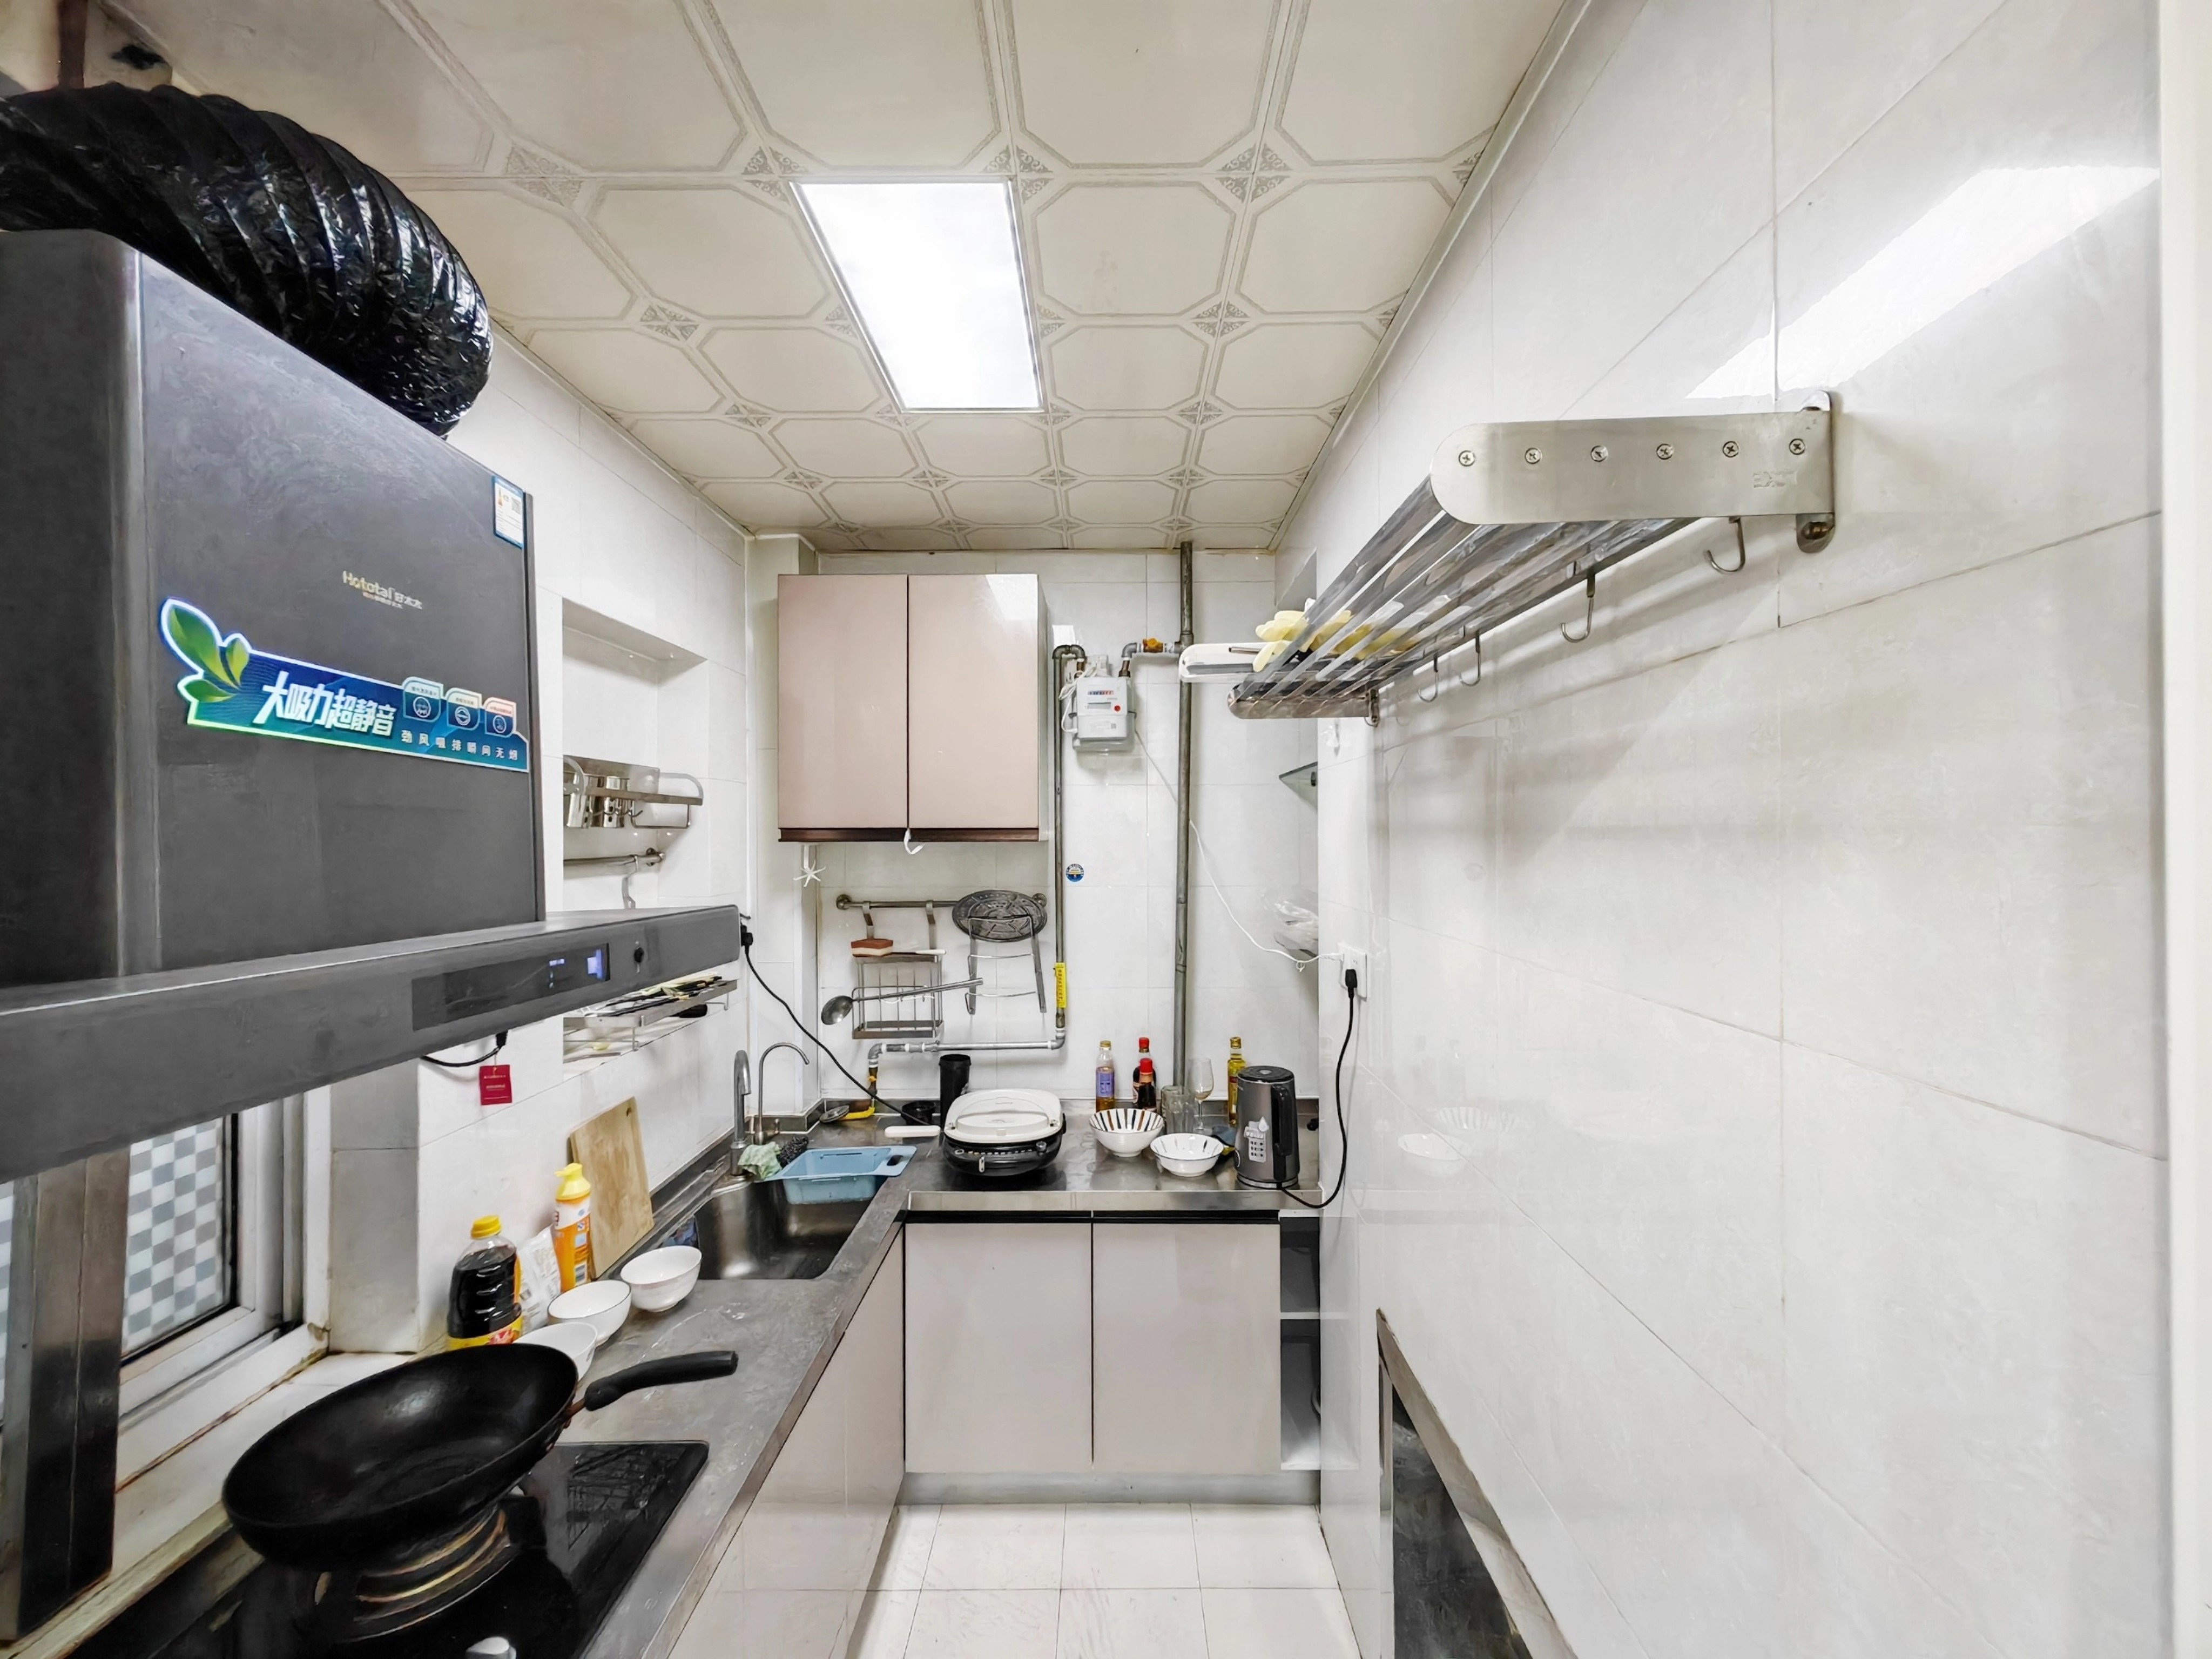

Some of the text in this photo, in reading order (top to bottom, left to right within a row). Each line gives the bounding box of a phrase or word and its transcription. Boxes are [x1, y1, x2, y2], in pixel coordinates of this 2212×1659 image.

[252, 670, 397, 737] 大吸力超静音
